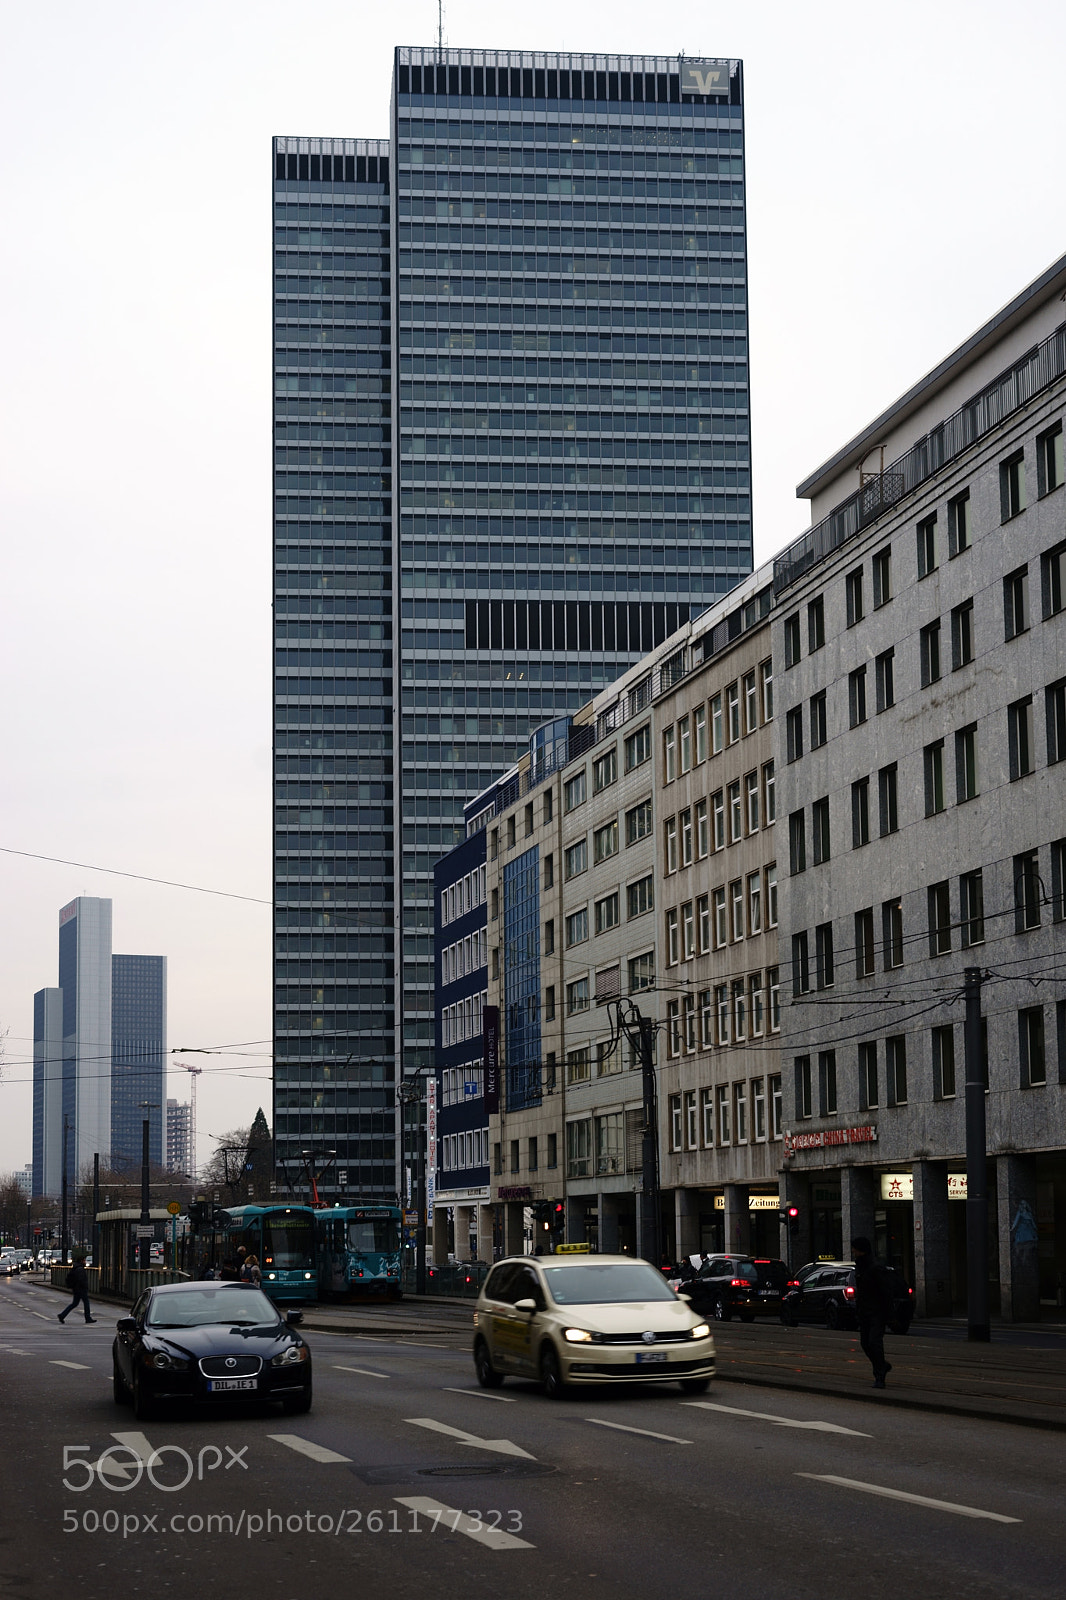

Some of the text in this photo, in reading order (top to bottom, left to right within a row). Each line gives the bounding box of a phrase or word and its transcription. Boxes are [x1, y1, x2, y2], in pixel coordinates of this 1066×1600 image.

[488, 1026, 496, 1093] Mercure HOTEL
[823, 1130, 845, 1146] CHINA
[846, 1126, 874, 1143] TRAVEL
[748, 1198, 780, 1209] Zeitung
